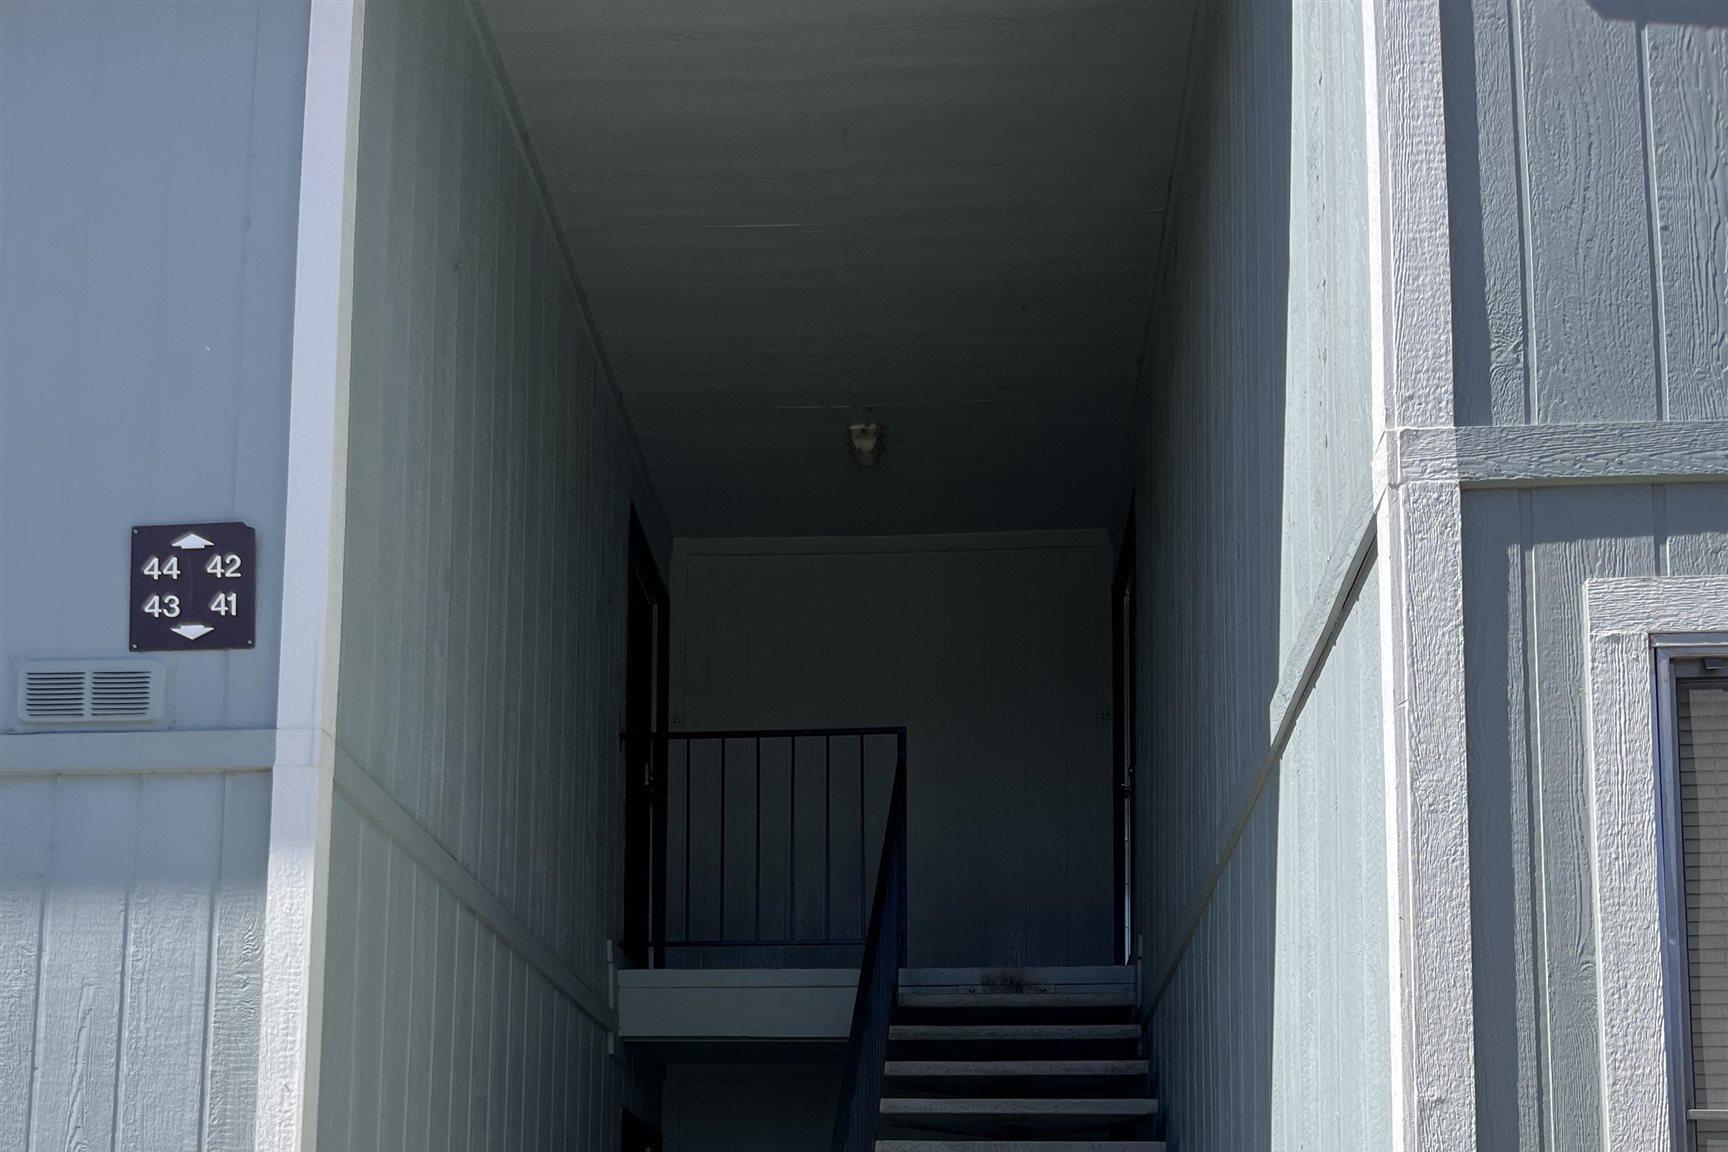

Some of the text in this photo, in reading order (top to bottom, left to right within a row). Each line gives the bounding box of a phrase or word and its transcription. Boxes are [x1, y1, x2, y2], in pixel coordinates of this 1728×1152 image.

[143, 554, 242, 580] 44 42
[143, 592, 237, 618] 43 41
